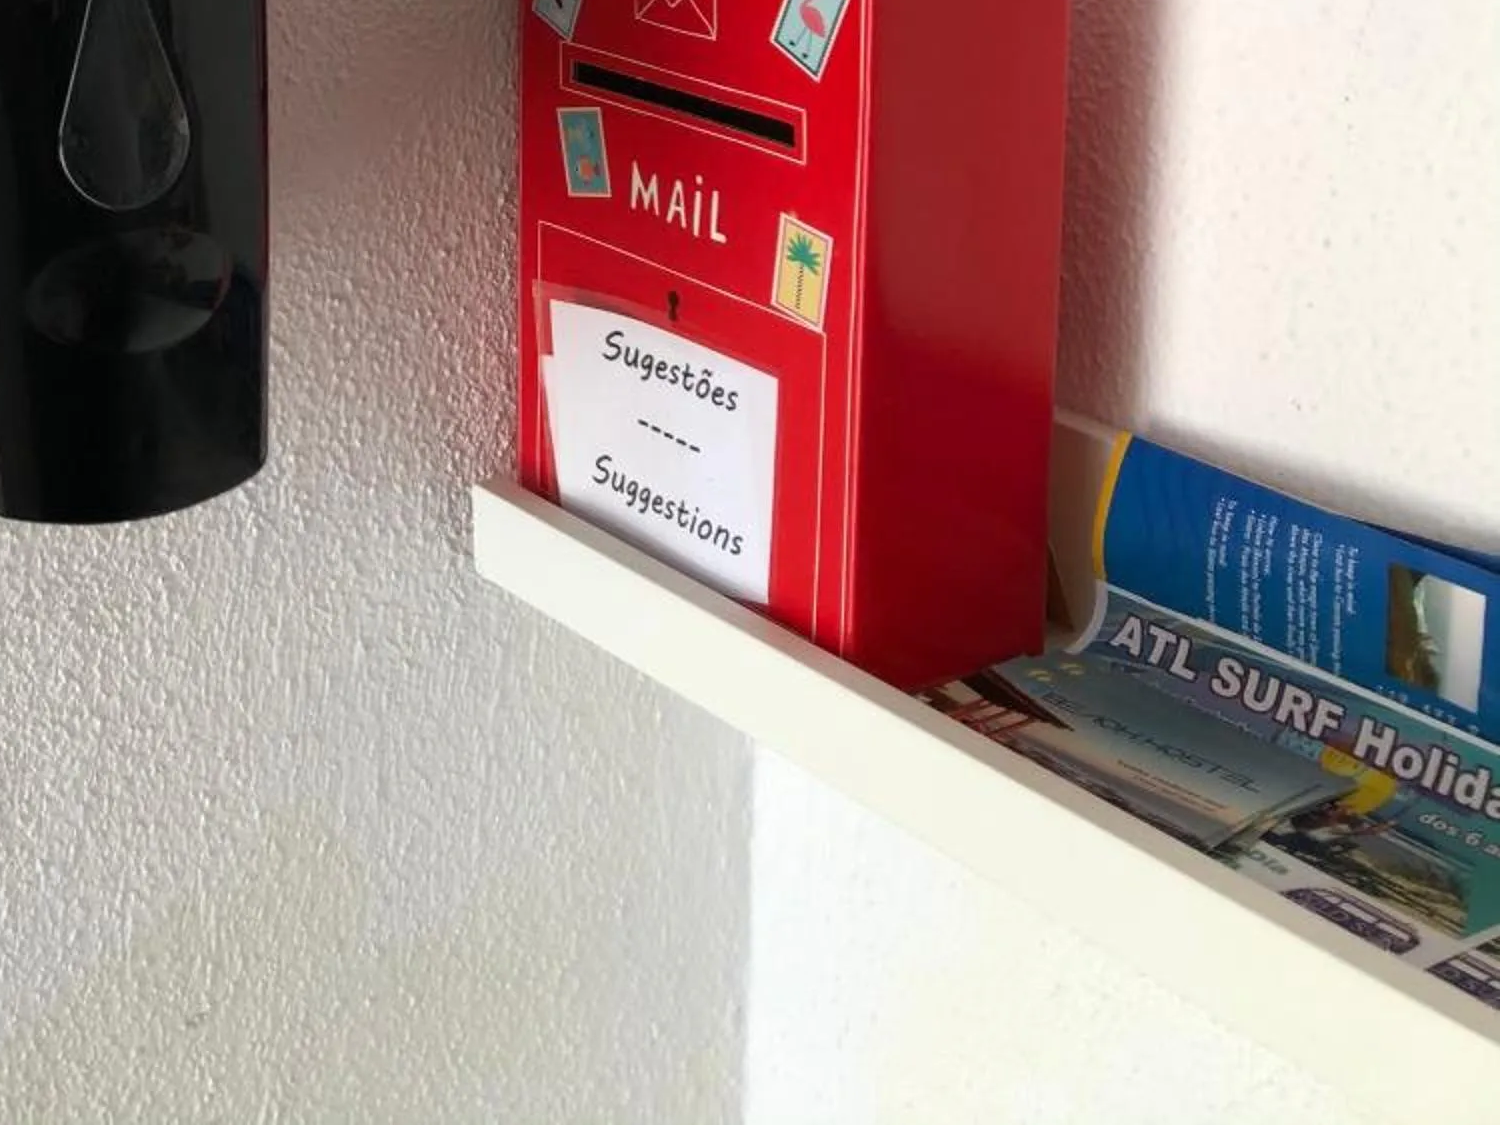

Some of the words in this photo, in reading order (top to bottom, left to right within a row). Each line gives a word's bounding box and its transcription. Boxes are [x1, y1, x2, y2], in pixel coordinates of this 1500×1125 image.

[602, 330, 739, 412] Sugestões
[592, 454, 744, 556] Suggestions
[1109, 615, 1198, 683] ATL
[1211, 657, 1346, 739] SURF
[1418, 813, 1460, 837] dos
[1465, 831, 1481, 847] 6
